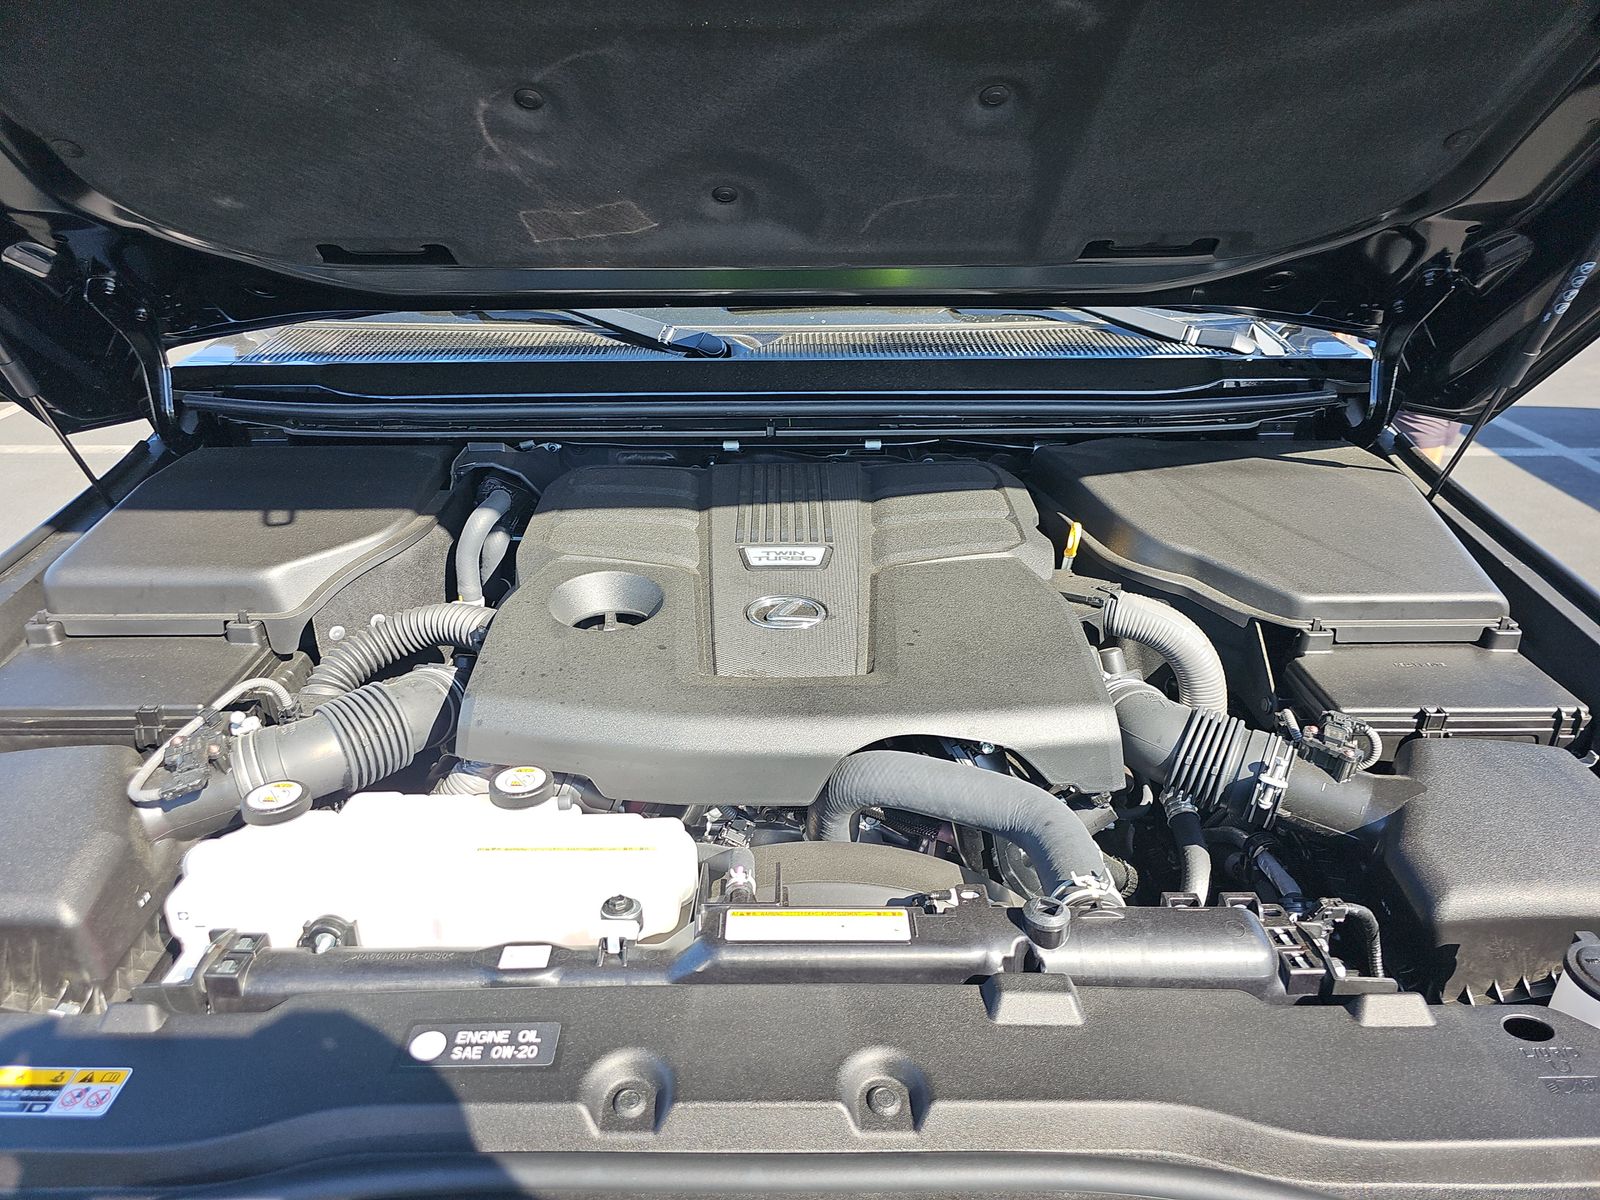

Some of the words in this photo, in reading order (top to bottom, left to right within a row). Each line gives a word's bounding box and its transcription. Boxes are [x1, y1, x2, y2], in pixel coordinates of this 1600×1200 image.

[454, 1030, 511, 1044] ENGINE
[517, 1029, 542, 1043] OIL
[450, 1045, 482, 1060] SAE
